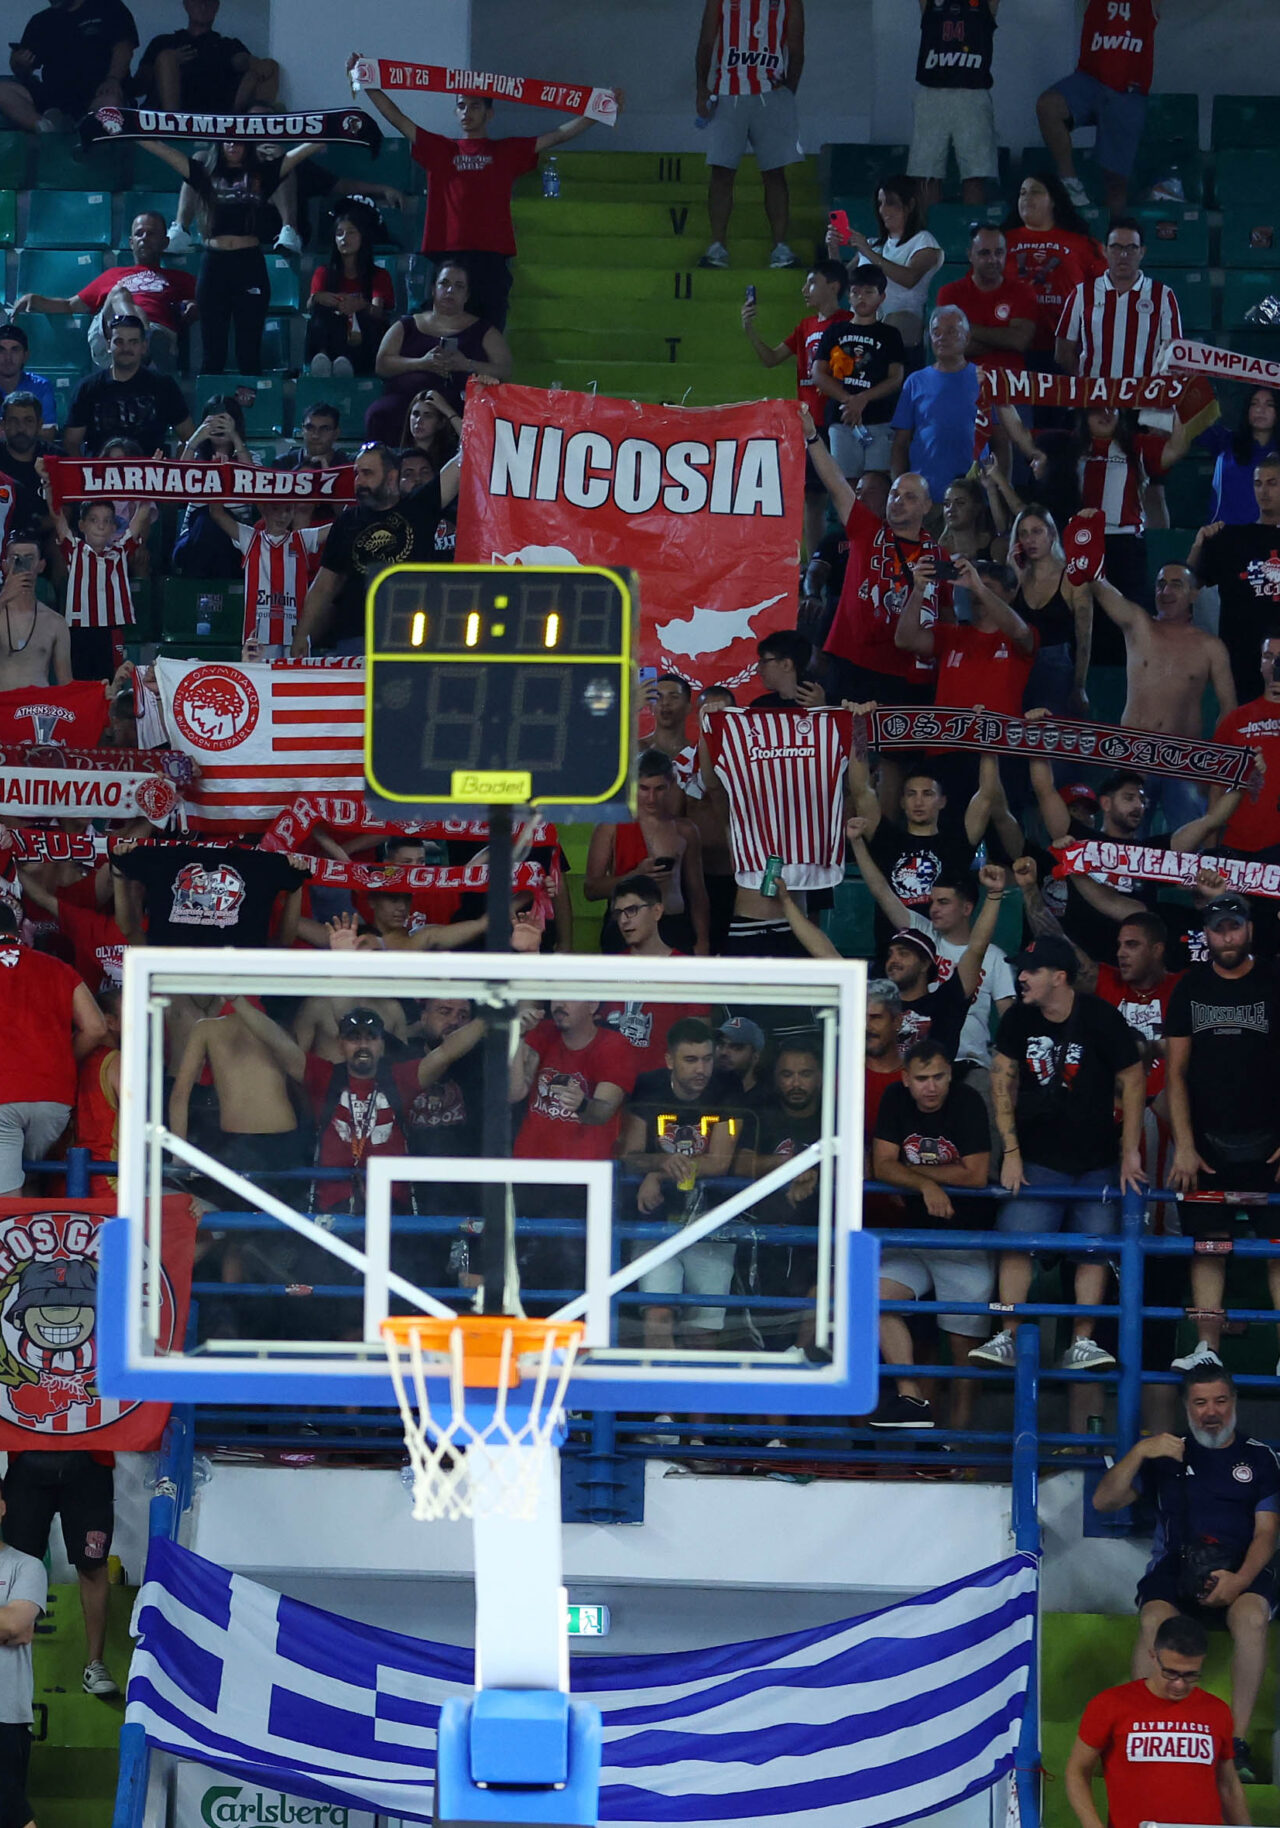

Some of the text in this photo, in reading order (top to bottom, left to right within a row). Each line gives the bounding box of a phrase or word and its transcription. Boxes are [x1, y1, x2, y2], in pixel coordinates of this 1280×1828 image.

[1106, 1, 1131, 21] 94
[1090, 30, 1143, 54] bwin
[726, 46, 780, 69] bwin
[924, 46, 983, 69] bwin
[445, 68, 525, 99] CHAMPIONS
[669, 206, 688, 235] V
[664, 336, 682, 363] T
[1172, 344, 1280, 378] OLYMPIAC
[984, 369, 1188, 400] YMPIACOS
[489, 416, 786, 518] NICOSIA
[81, 466, 339, 496] LARNACA REDS 7
[192, 665, 260, 711] ΟΛΥΜΠΙΑΚΟΣ
[14, 706, 49, 720] ATHENS
[749, 745, 816, 762] Stoiximan
[1219, 752, 1237, 776] 7
[406, 862, 544, 888] GLOY
[1082, 841, 1118, 869] 40
[1125, 845, 1220, 875] YEARS
[1221, 858, 1280, 893] TOG
[1190, 1000, 1270, 1032] LONSDALE
[55, 1267, 66, 1281] 7
[1132, 1721, 1211, 1733] OLYMPIACOS
[1131, 1736, 1211, 1758] PIRAEUS
[200, 1785, 349, 1828] Carlsberg
